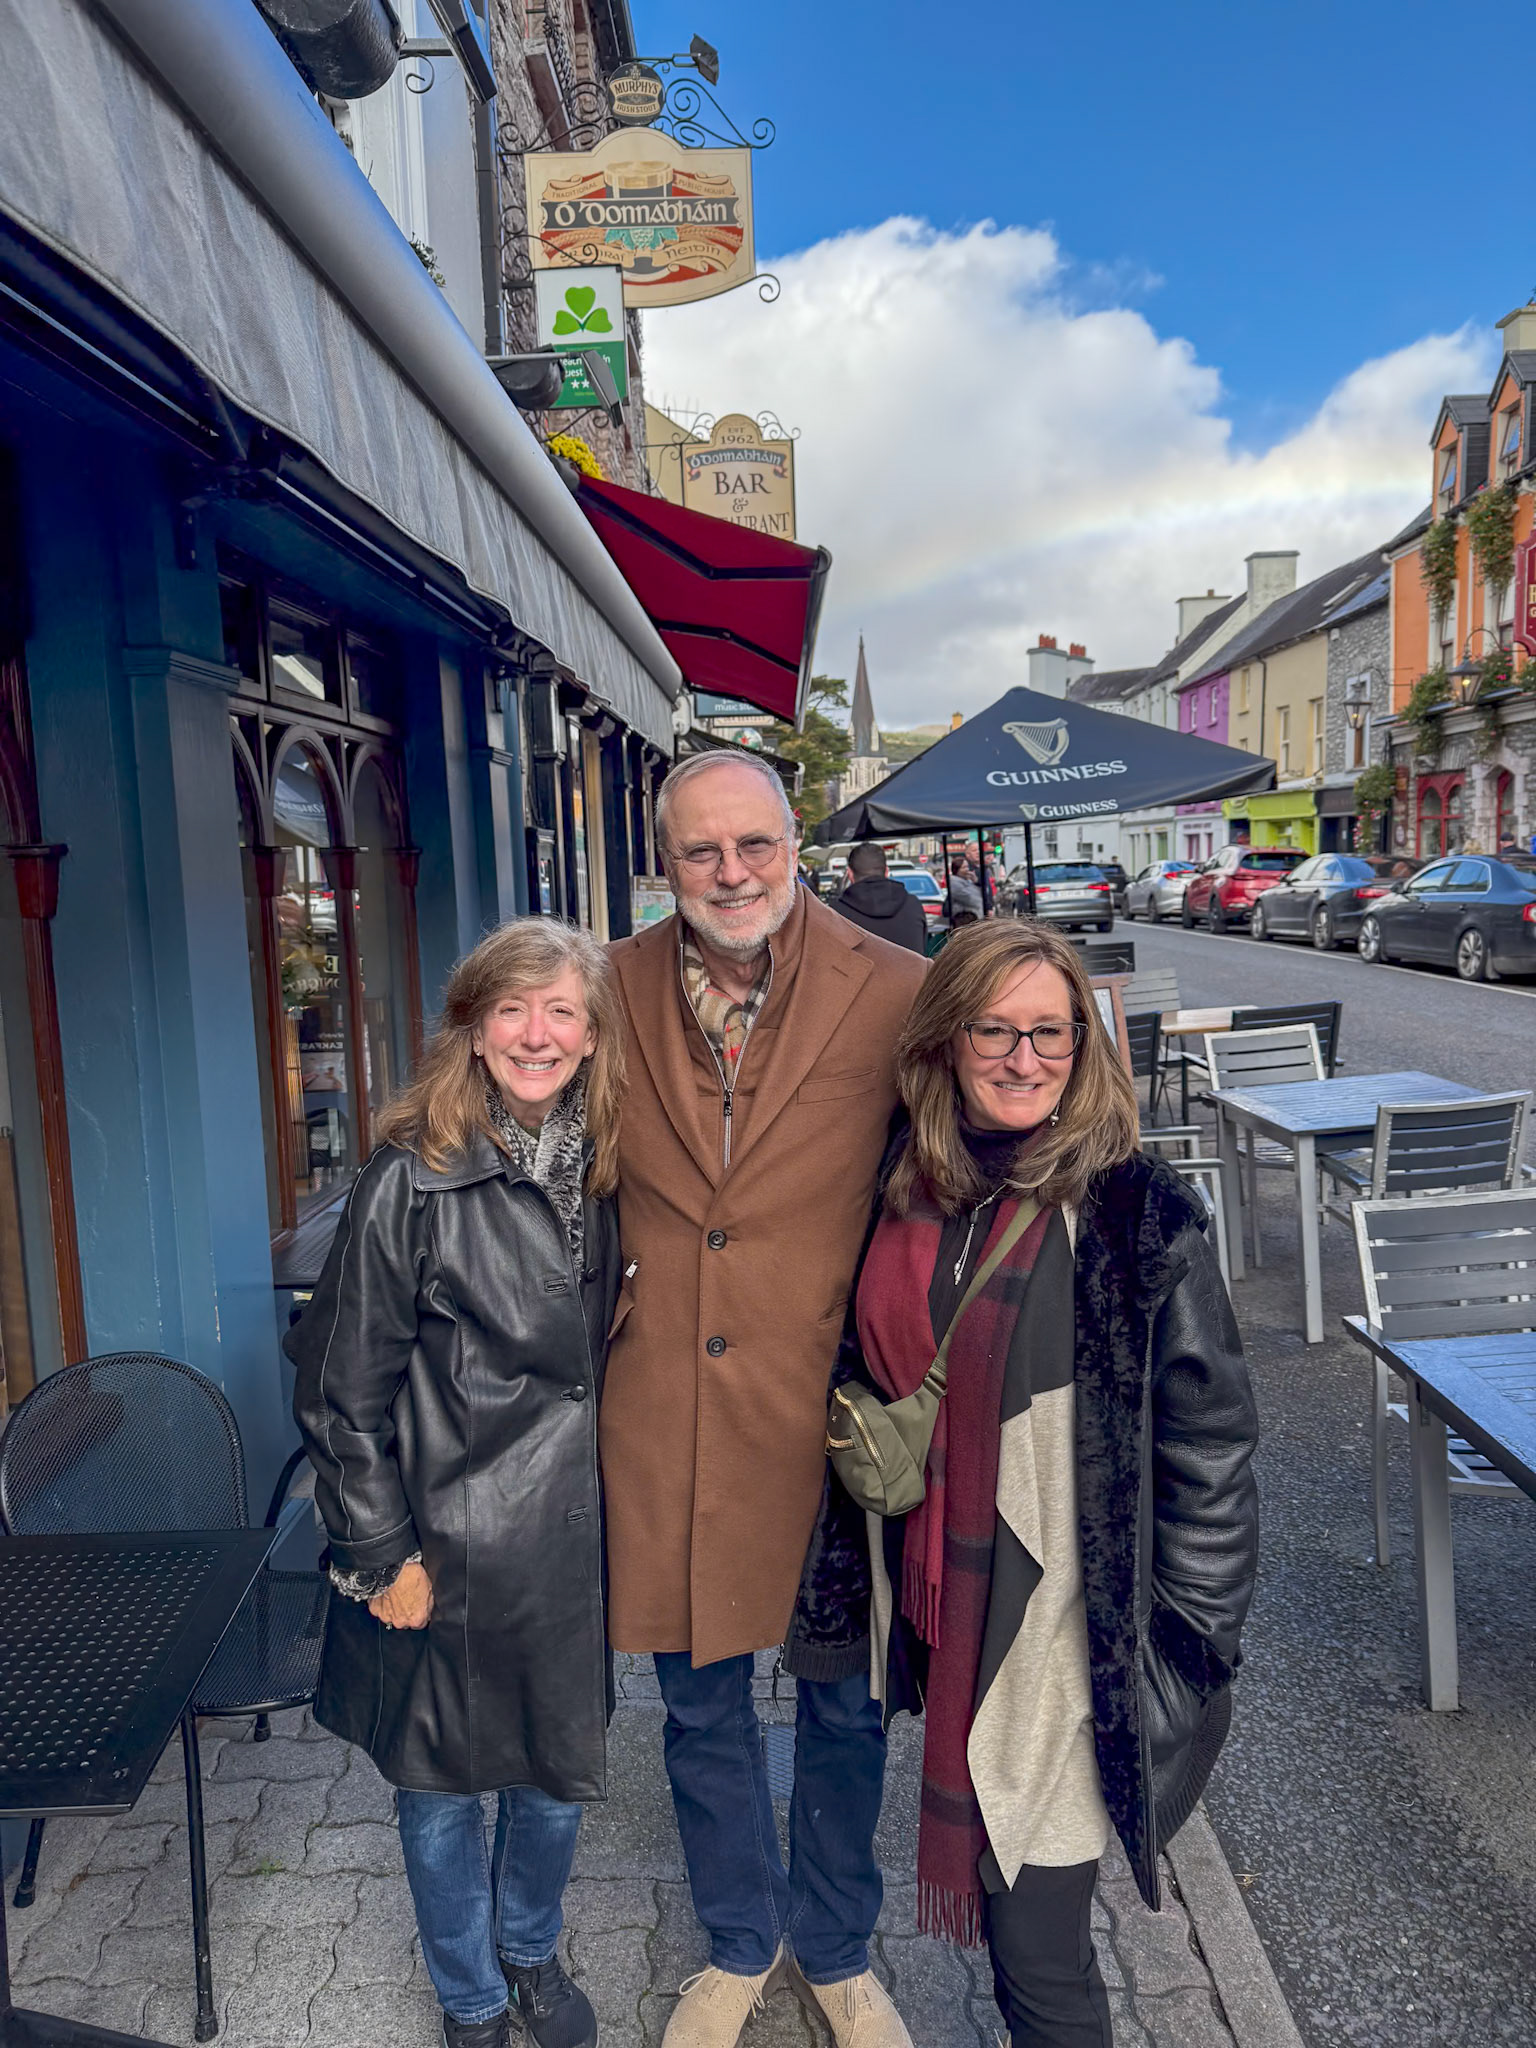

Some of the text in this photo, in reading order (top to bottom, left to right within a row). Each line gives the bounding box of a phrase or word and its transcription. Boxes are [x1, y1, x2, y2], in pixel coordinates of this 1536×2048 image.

[635, 103, 657, 113] STOUT
[552, 182, 598, 198] TRADITIONAL
[678, 178, 701, 192] PUBLIC
[721, 434, 755, 445] 1962
[713, 471, 772, 496] BAR
[732, 498, 749, 513] &
[986, 760, 1128, 786] GUINNESS
[1039, 799, 1119, 818] GUINNESS
